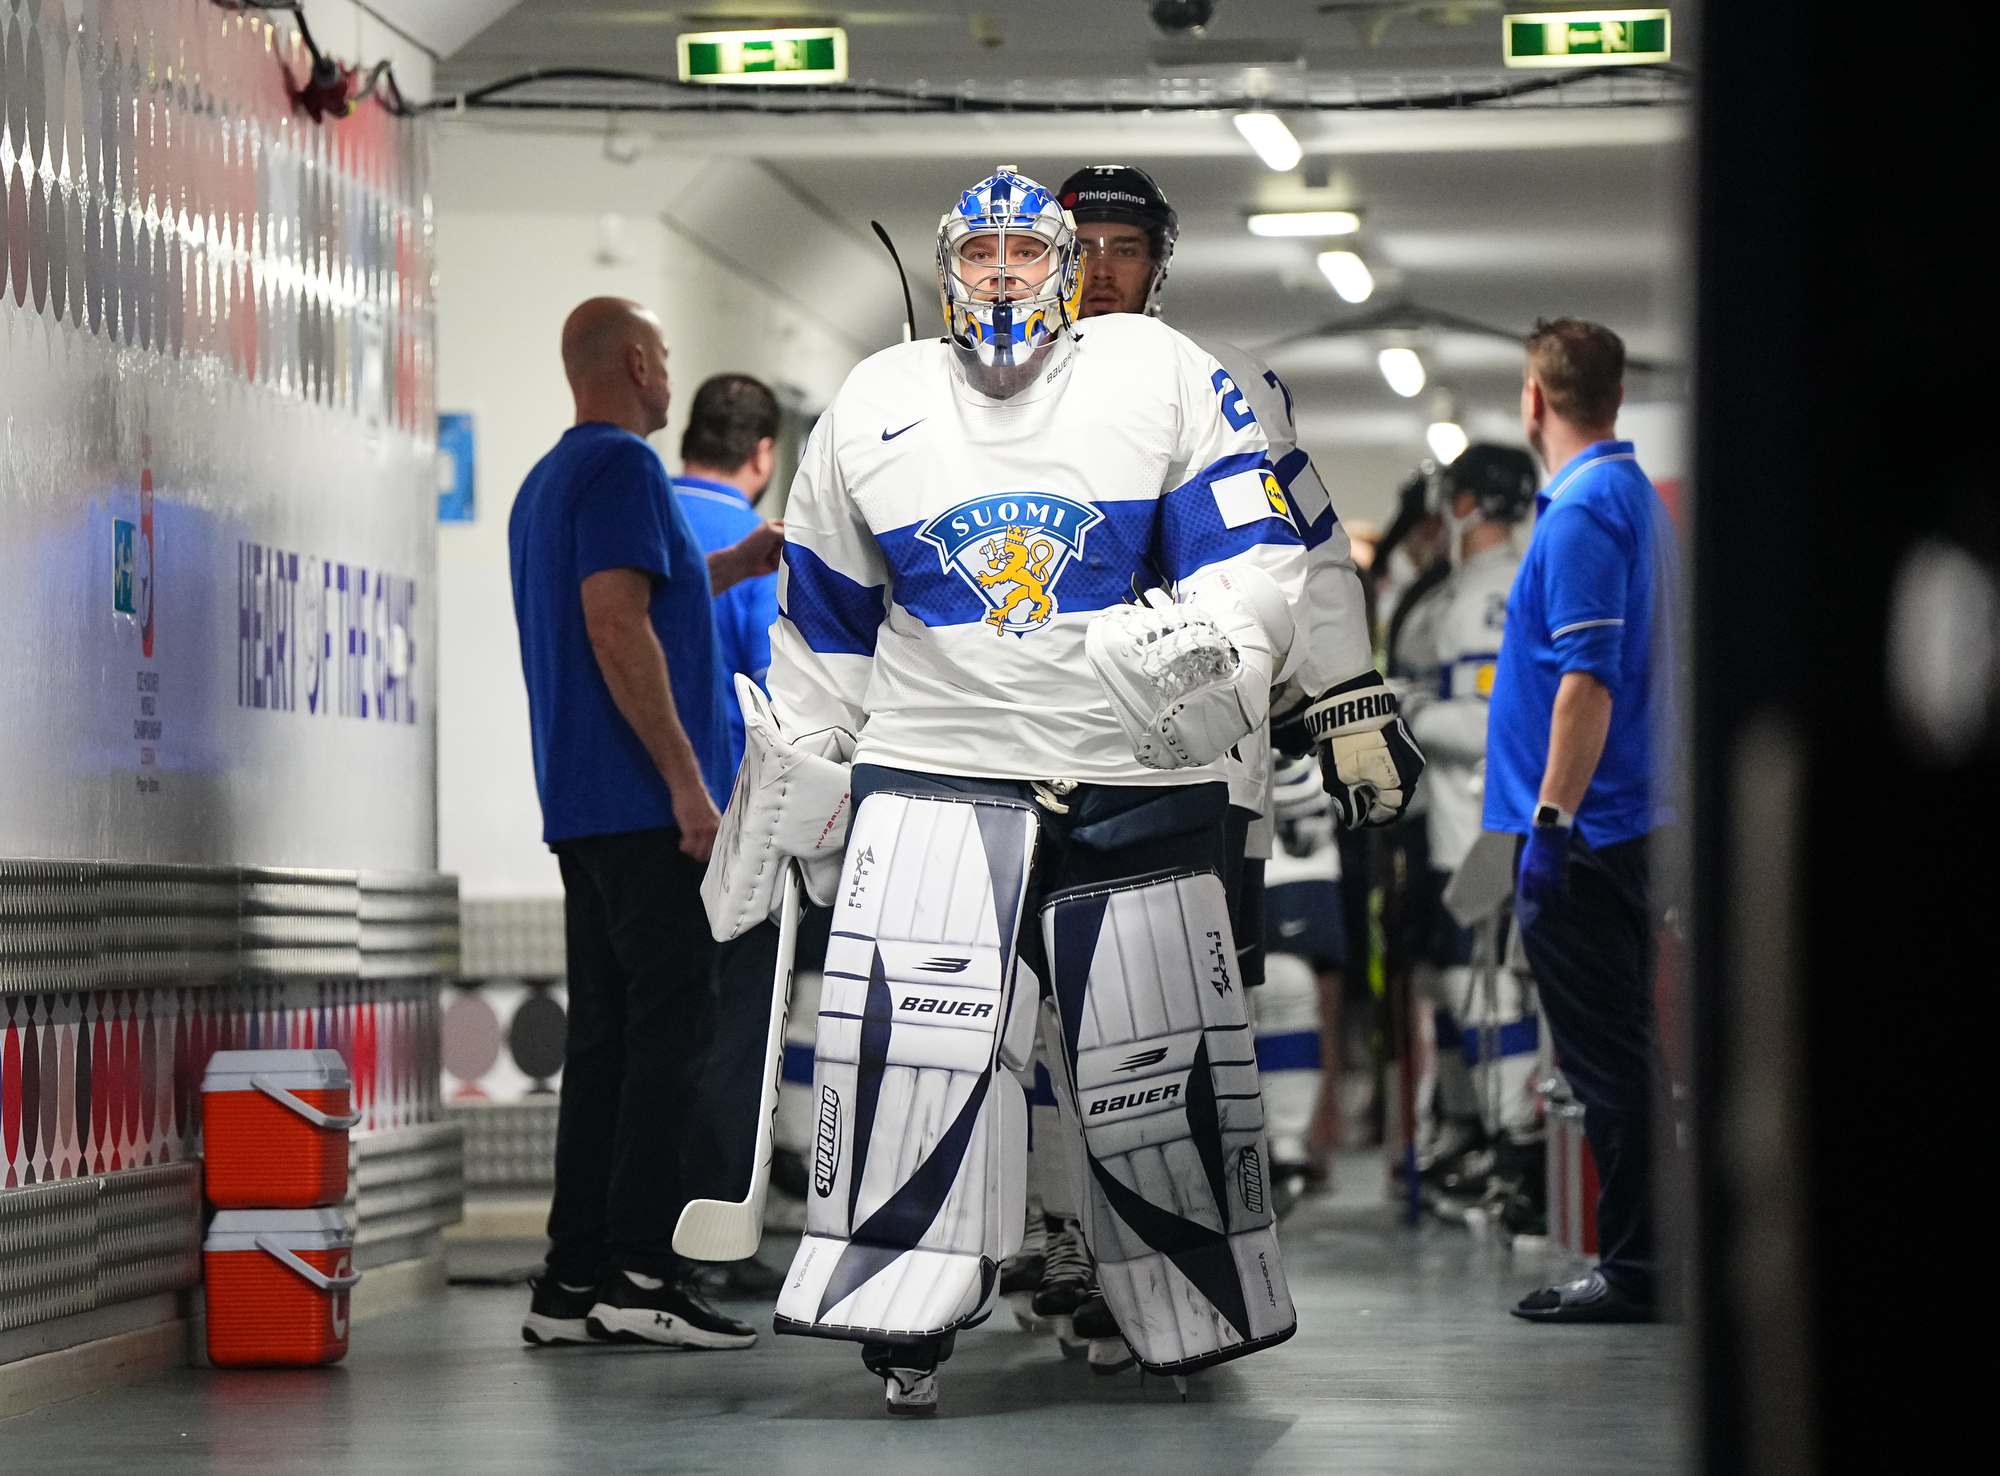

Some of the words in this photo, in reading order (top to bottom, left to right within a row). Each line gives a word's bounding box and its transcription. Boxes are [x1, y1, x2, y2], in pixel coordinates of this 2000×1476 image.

[1078, 190, 1147, 205] Pihlajalinna
[1262, 369, 1294, 428] 7
[951, 502, 1066, 537] SUOMI
[1304, 692, 1399, 737] WARRIO
